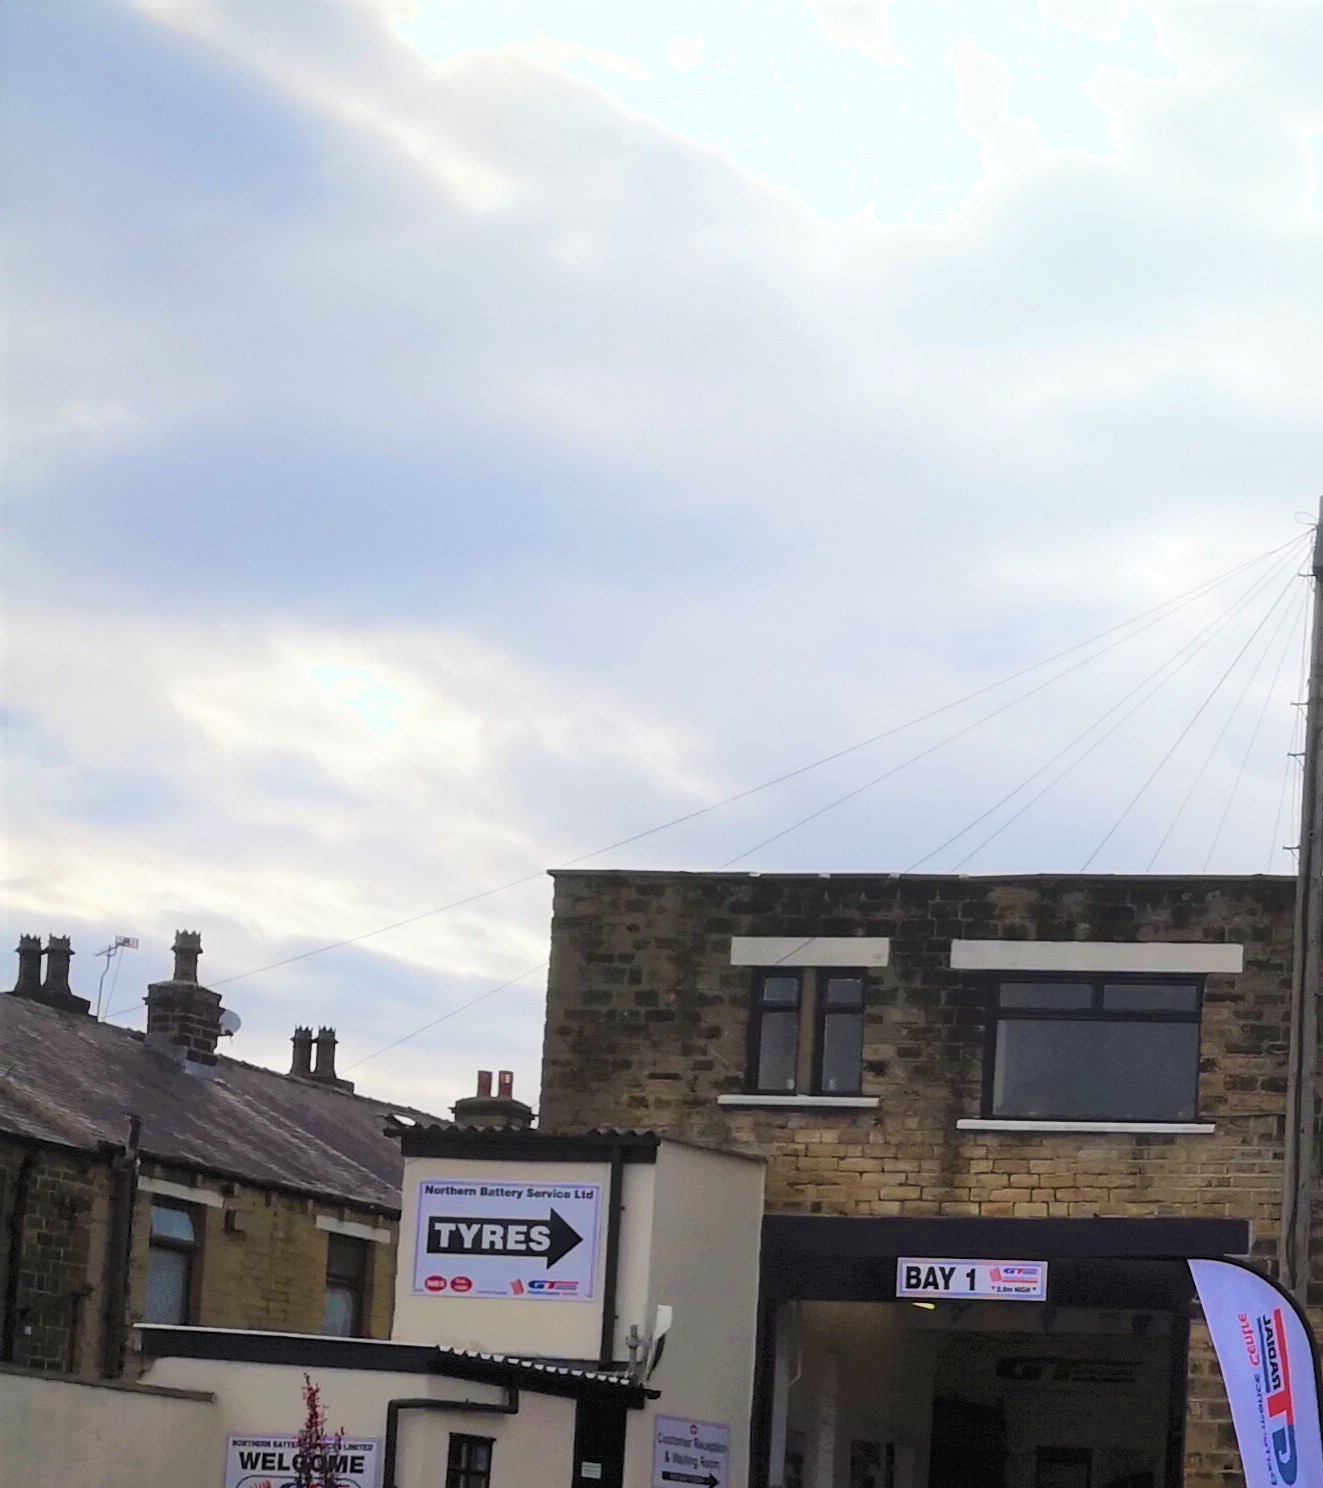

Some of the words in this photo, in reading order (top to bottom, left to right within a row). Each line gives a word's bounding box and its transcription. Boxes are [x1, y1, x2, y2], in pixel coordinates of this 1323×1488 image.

[424, 1185, 477, 1196] Northern
[480, 1187, 523, 1200] Battery
[526, 1188, 571, 1199] Service
[574, 1189, 594, 1200] Ltd
[434, 1222, 551, 1252] TYRES
[905, 1266, 956, 1291] BAY
[966, 1268, 976, 1291] 1
[239, 1451, 365, 1474] WELCOME
